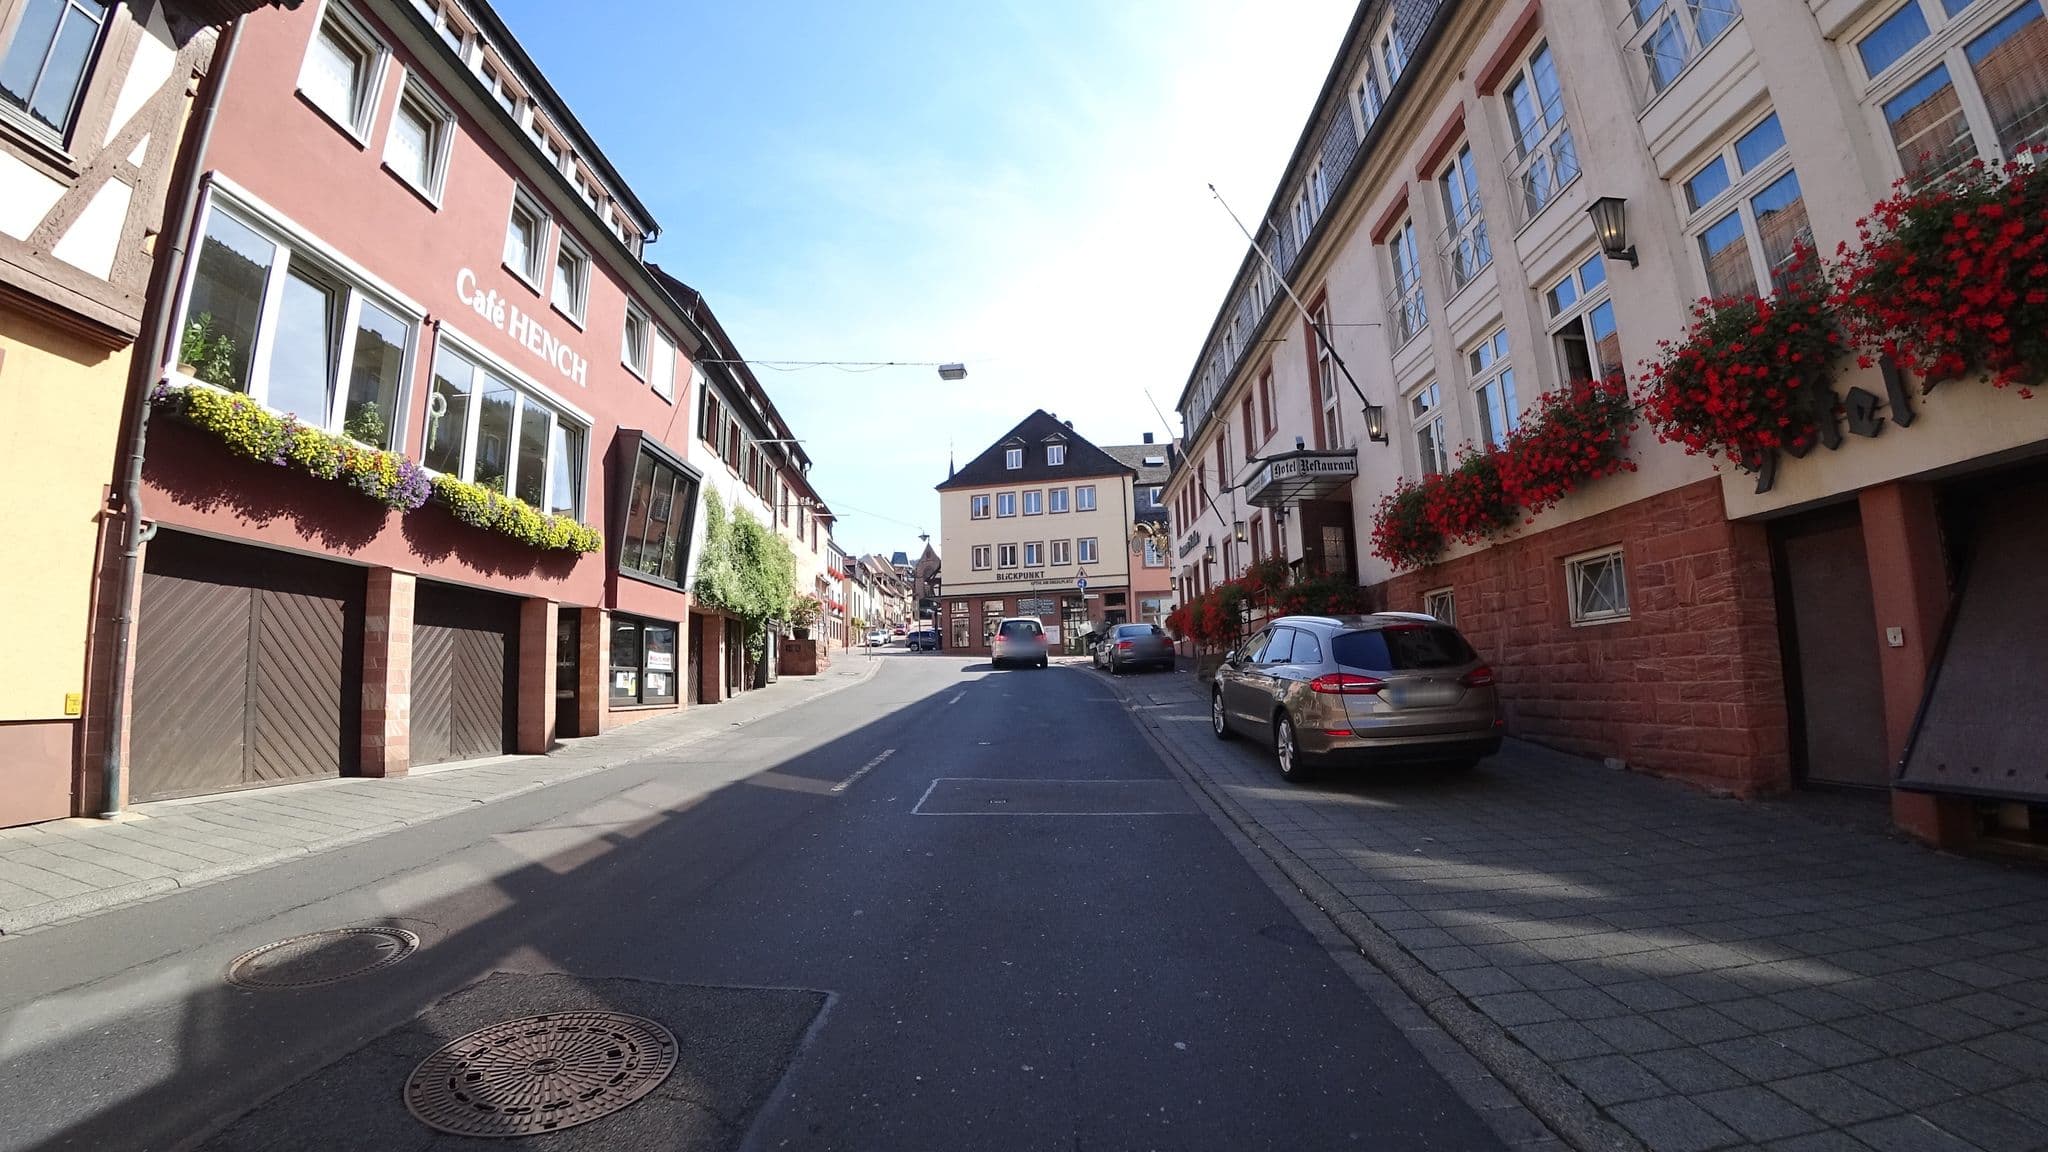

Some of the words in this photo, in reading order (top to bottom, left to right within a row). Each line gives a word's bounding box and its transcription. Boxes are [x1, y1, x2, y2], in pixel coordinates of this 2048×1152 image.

[456, 267, 506, 330] Café
[508, 304, 587, 388] HENCH
[1274, 461, 1297, 478] Hotel
[1300, 459, 1354, 475] Restaurant
